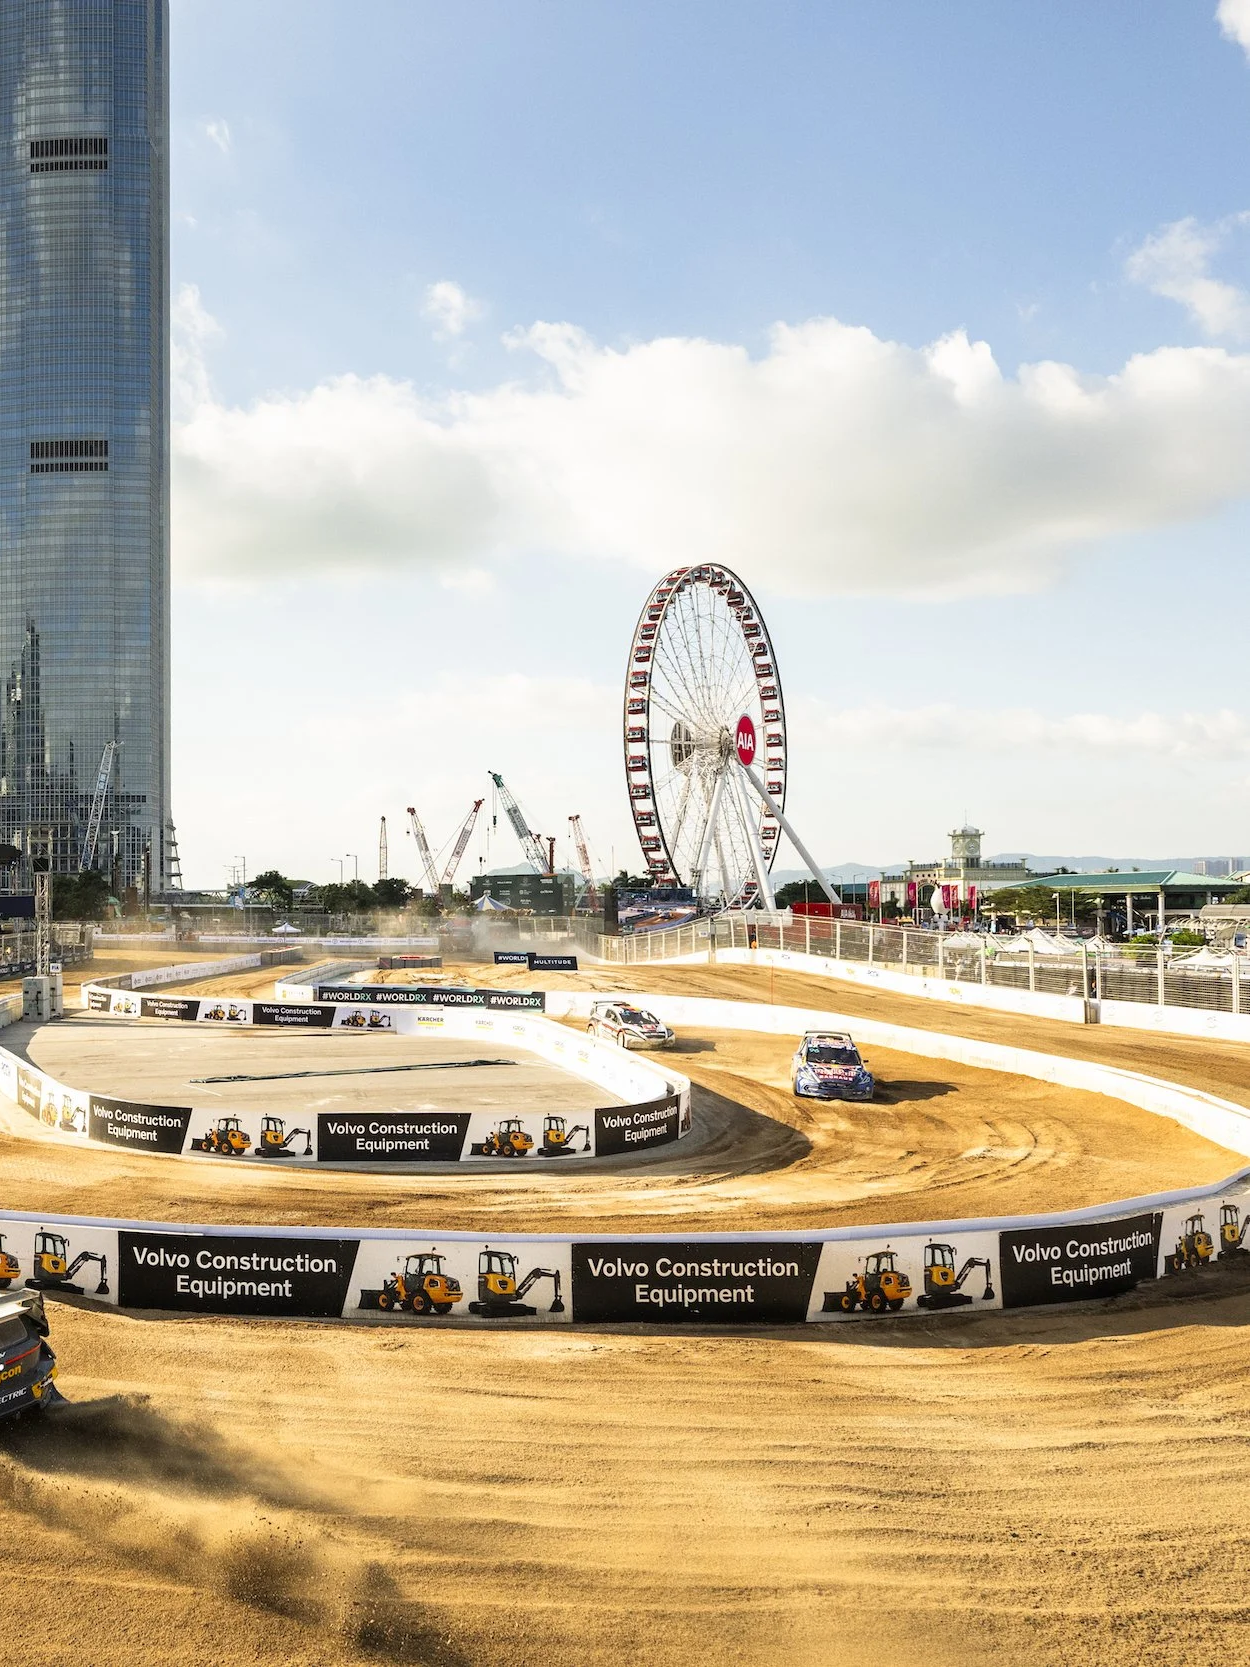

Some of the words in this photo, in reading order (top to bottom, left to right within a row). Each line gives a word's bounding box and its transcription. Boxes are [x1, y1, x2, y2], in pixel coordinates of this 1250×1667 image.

[737, 731, 754, 751] AIA
[321, 992, 372, 1001] #WORLDRX
[376, 993, 427, 1002] #WORLDRX
[433, 994, 485, 1004] #WORLDRX
[490, 995, 541, 1007] #WORLDRX
[280, 1007, 321, 1015] Construction
[93, 1104, 113, 1120] Volvo
[114, 1108, 182, 1128] Construction
[602, 1115, 632, 1129] Volvo
[633, 1105, 678, 1124] Construction
[107, 1122, 158, 1142] Equipment
[327, 1121, 366, 1136] Volvo
[369, 1121, 458, 1136] Construction
[624, 1123, 668, 1142] Equipment
[355, 1137, 430, 1153] Equipment
[1012, 1244, 1061, 1263] Volvo
[1065, 1230, 1152, 1258] Construction
[132, 1246, 190, 1269] Volvo
[195, 1249, 337, 1274] Construction
[587, 1258, 649, 1277] Volvo
[655, 1257, 799, 1278] Construction
[1050, 1259, 1131, 1287] Equipment
[176, 1274, 292, 1299] Equipment
[635, 1284, 754, 1308] Equipment
